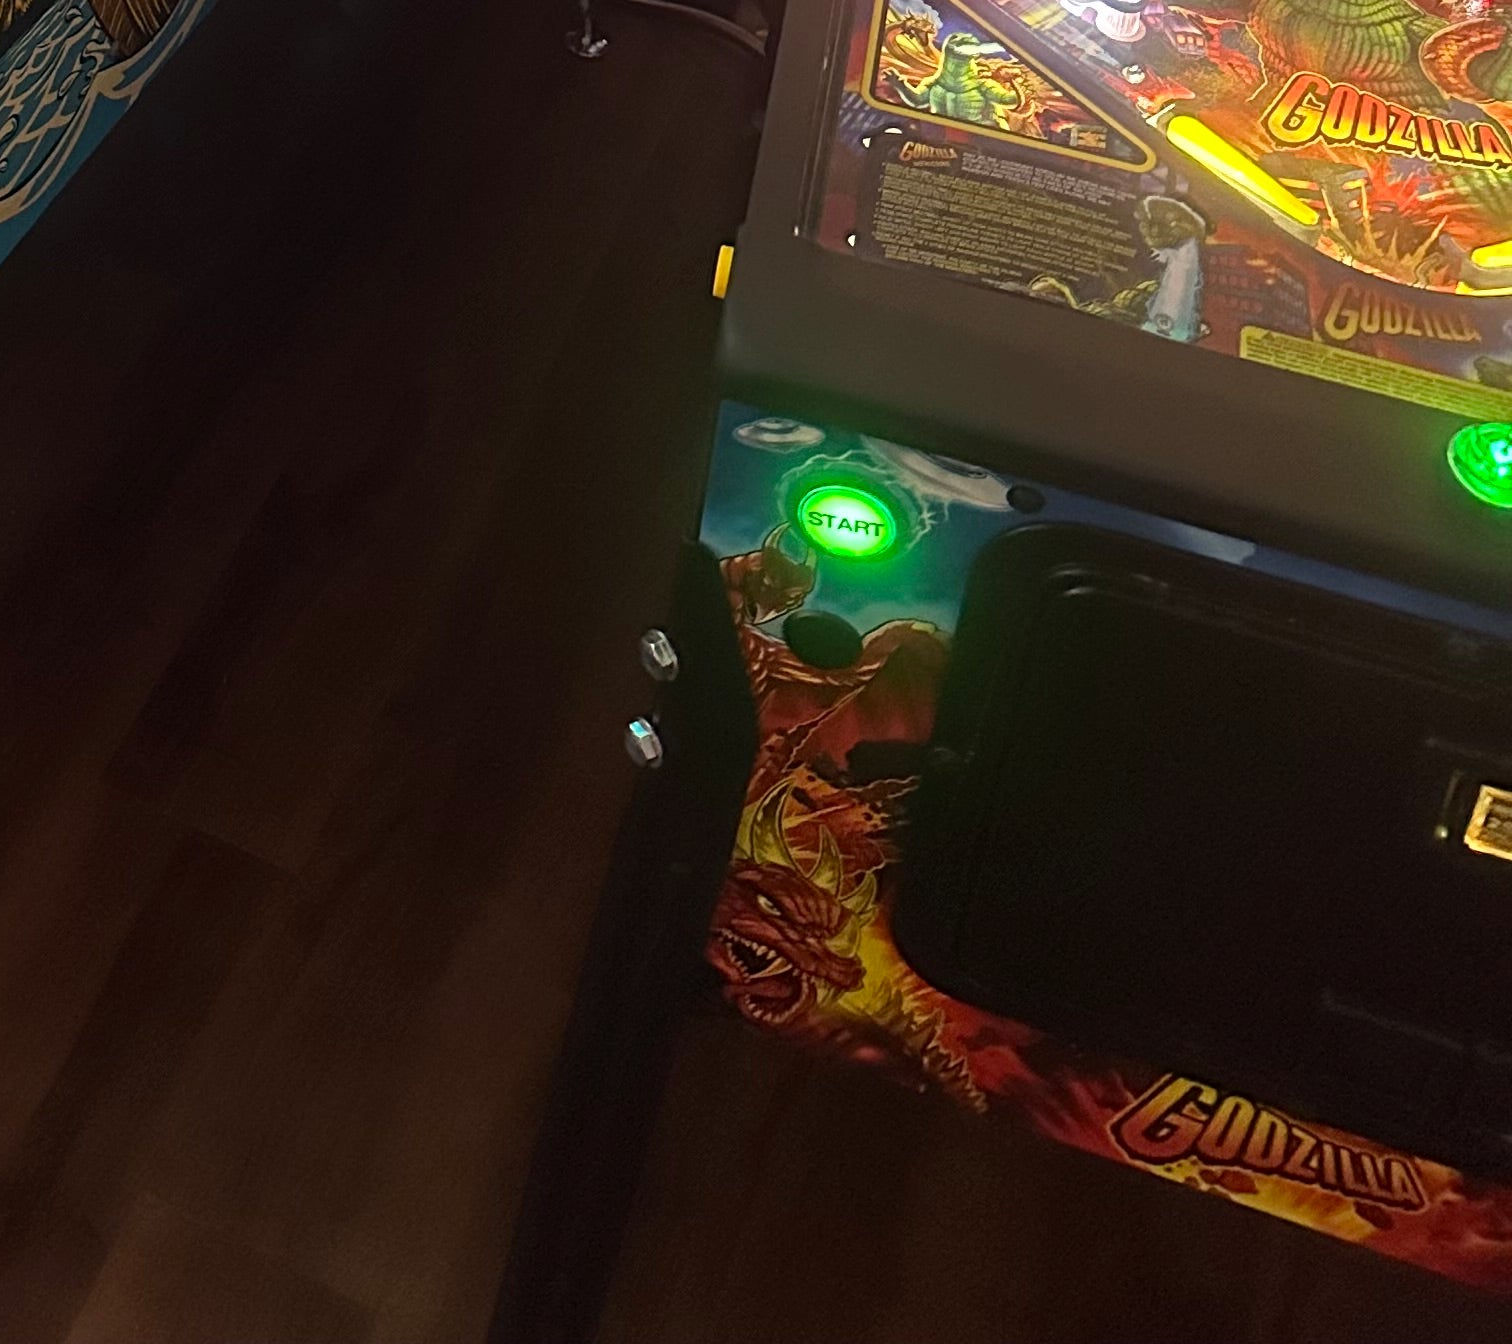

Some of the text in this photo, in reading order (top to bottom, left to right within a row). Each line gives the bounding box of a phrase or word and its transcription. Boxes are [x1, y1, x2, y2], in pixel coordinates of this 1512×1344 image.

[1268, 72, 1512, 165] GODZILLA
[898, 140, 959, 162] GODZILLA
[806, 511, 887, 539] START
[1126, 1072, 1425, 1210] GODZILLA
